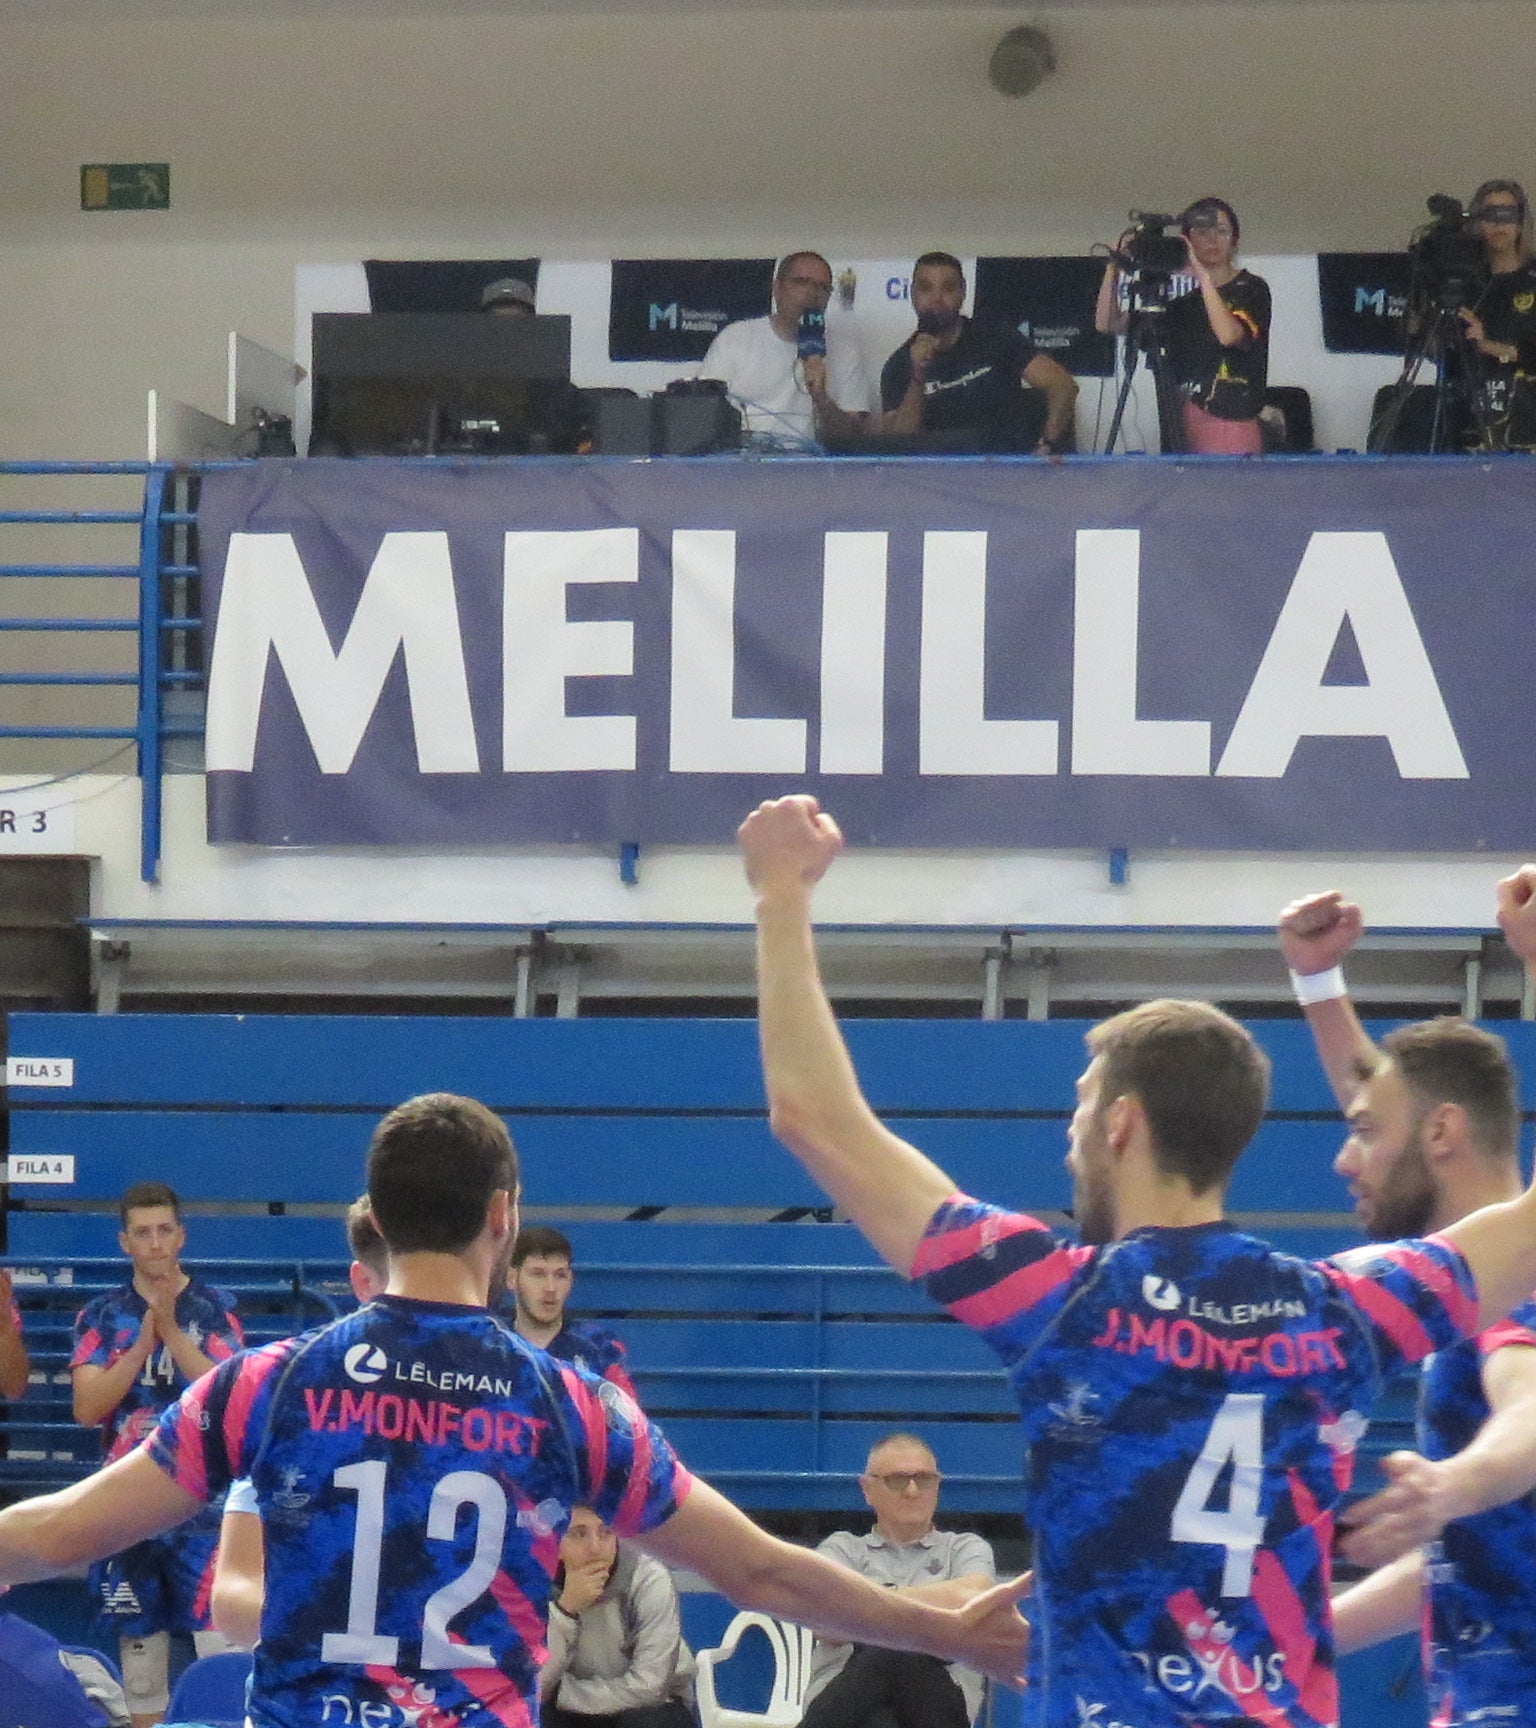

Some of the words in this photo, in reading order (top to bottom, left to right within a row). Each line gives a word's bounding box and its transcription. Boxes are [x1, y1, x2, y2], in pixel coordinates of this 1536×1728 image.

[205, 528, 1470, 778] MELILLA
[31, 811, 47, 834] 3
[16, 1064, 49, 1078] FILA
[53, 1064, 62, 1078] 5
[16, 1161, 49, 1175] FILA
[53, 1161, 63, 1175] 4
[140, 1345, 175, 1387] 14
[1092, 1306, 1347, 1377] J.MONFORT
[304, 1388, 549, 1457] V.MONFORT
[1170, 1392, 1266, 1599] 4
[321, 1460, 508, 1670] 12
